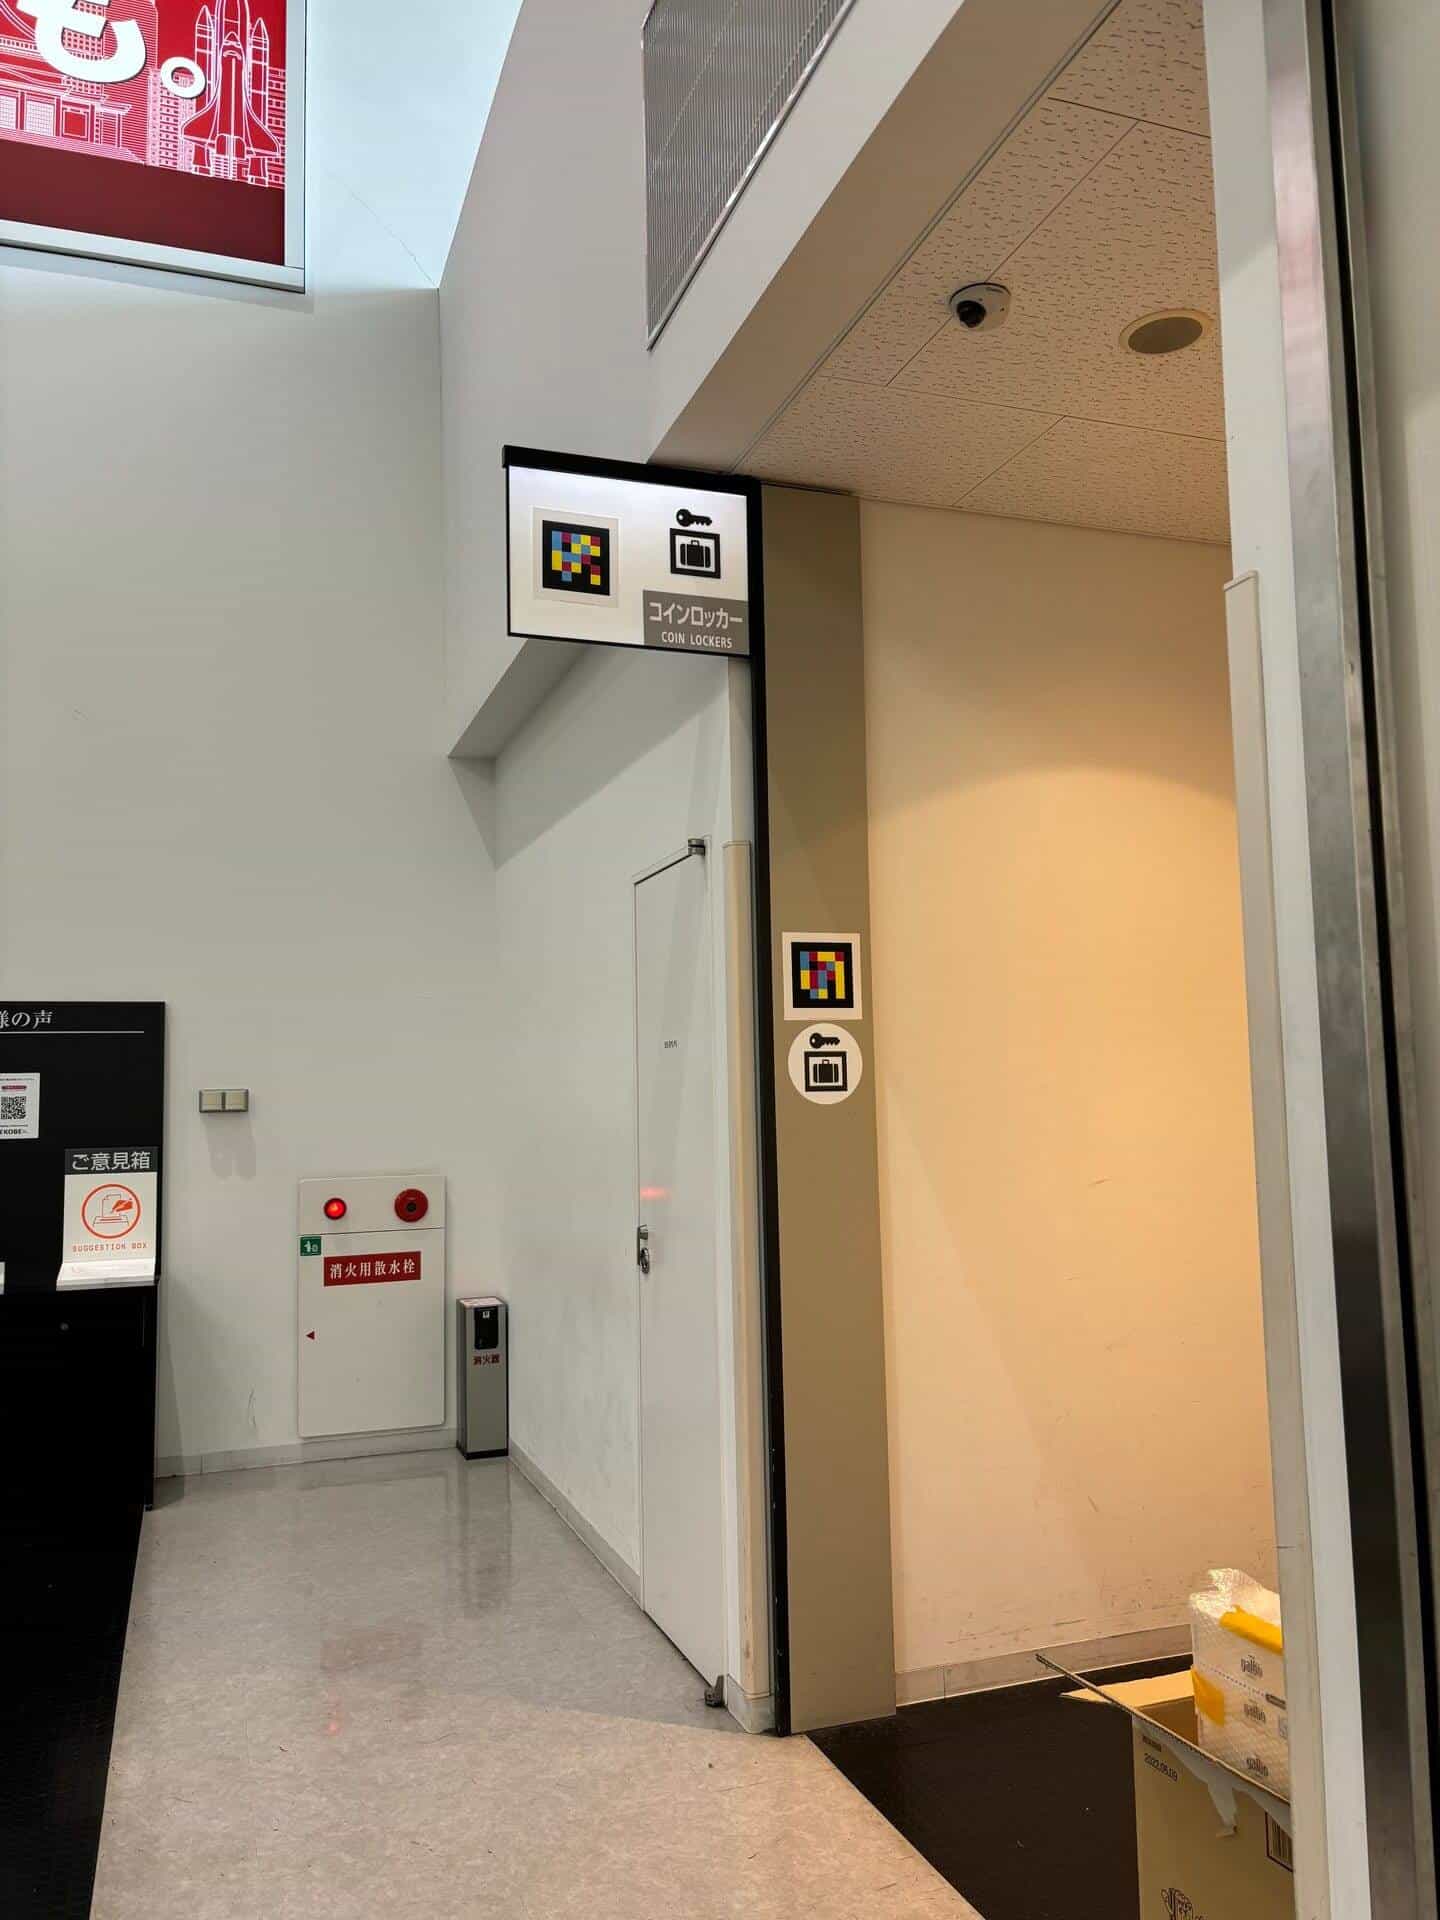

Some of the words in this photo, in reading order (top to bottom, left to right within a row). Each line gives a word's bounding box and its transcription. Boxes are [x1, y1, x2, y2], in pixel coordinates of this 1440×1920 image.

[649, 602, 744, 629] コインロッカー
[661, 631, 685, 644] COIN
[690, 633, 733, 648] LOCKERS
[72, 1151, 151, 1171] ご意見箱
[72, 1243, 126, 1252] SUGGESTION
[329, 1258, 416, 1279] 消火用散水栓
